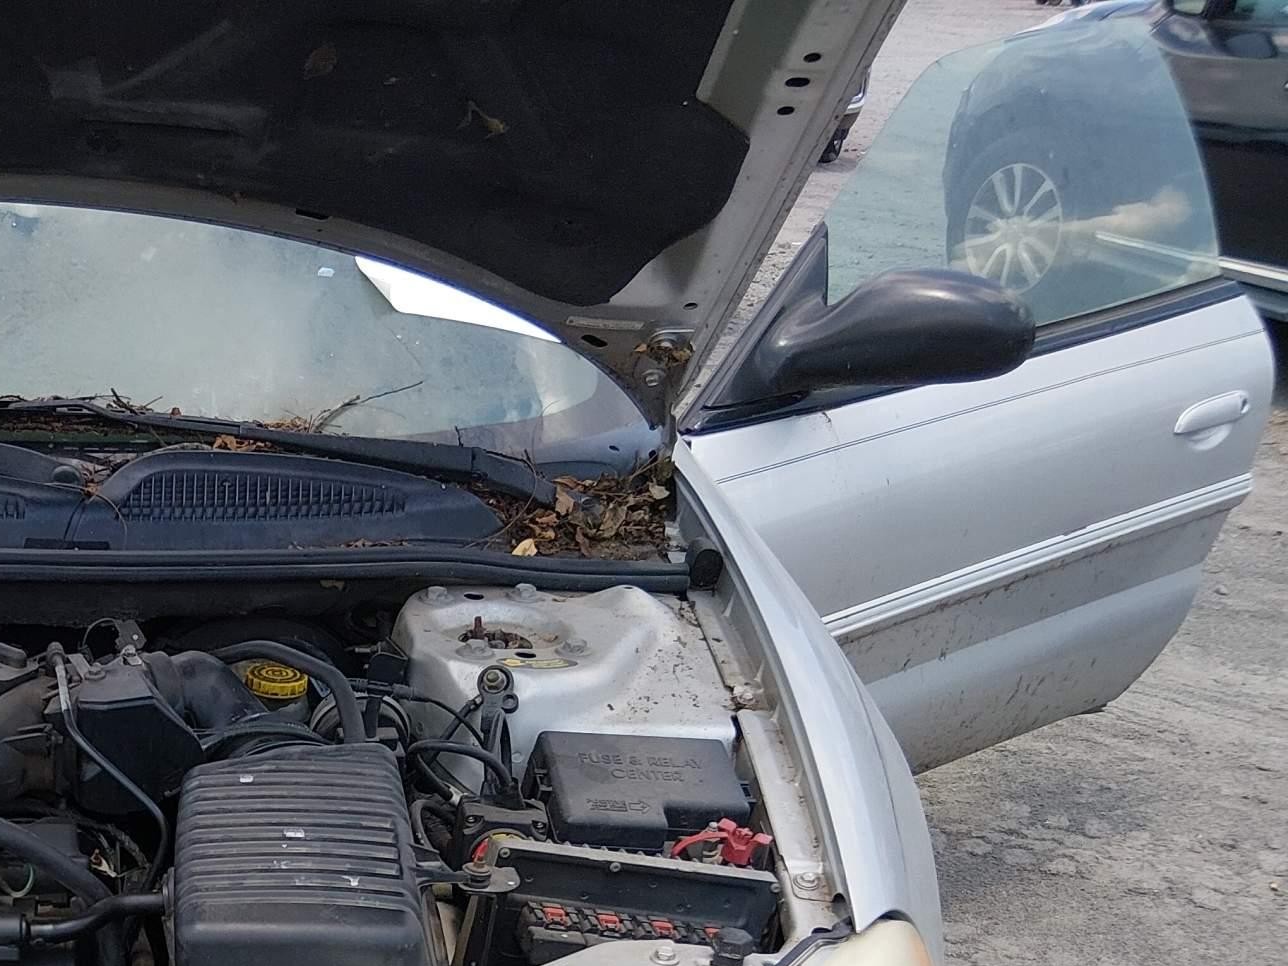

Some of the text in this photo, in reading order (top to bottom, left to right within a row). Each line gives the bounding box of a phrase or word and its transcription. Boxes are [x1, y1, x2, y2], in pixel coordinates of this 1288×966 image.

[577, 752, 703, 769] FUSE & RELAY
[611, 768, 685, 782] CENTER
